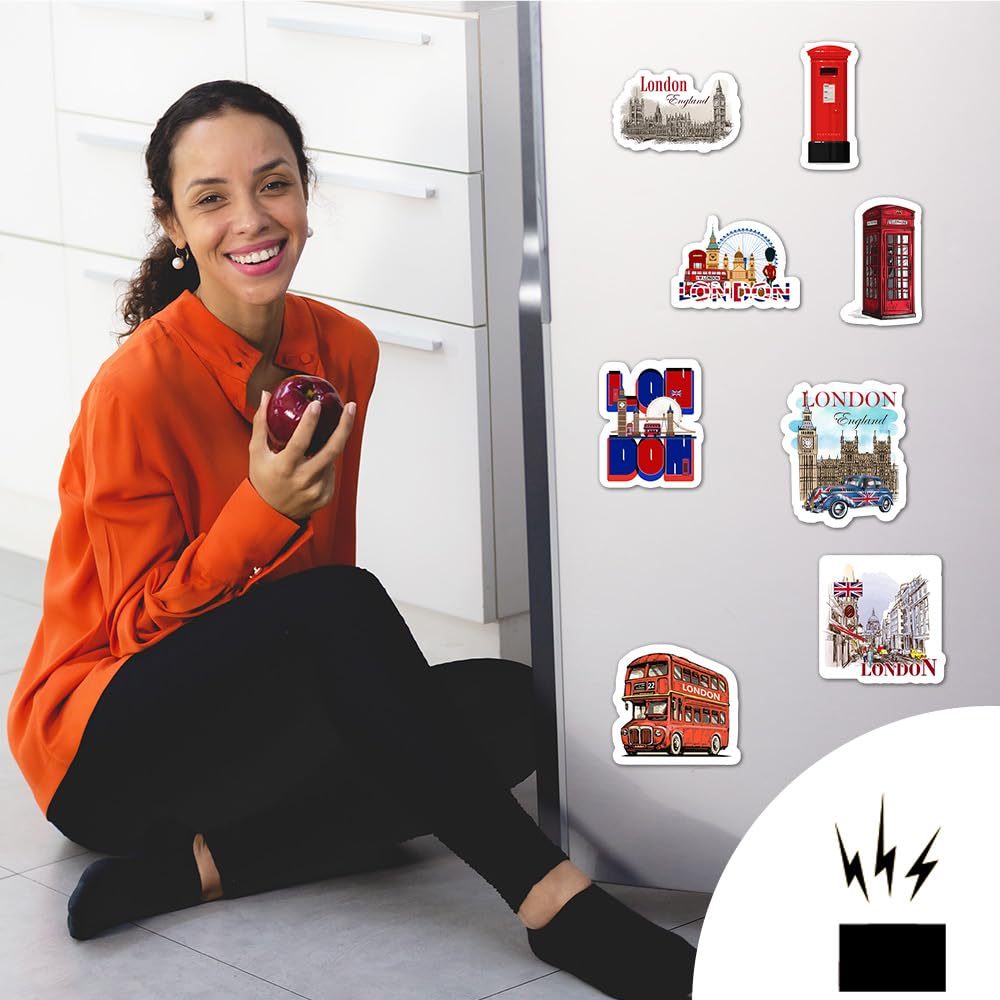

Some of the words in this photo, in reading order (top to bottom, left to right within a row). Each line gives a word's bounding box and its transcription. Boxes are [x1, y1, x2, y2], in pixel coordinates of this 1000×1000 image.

[641, 76, 687, 92] London
[666, 94, 711, 109] England
[679, 281, 790, 302] LONDON
[802, 390, 897, 408] LONDON
[834, 412, 888, 430] England
[607, 435, 694, 482] DON
[861, 658, 937, 677] LONDON
[682, 683, 721, 701] LONDON
